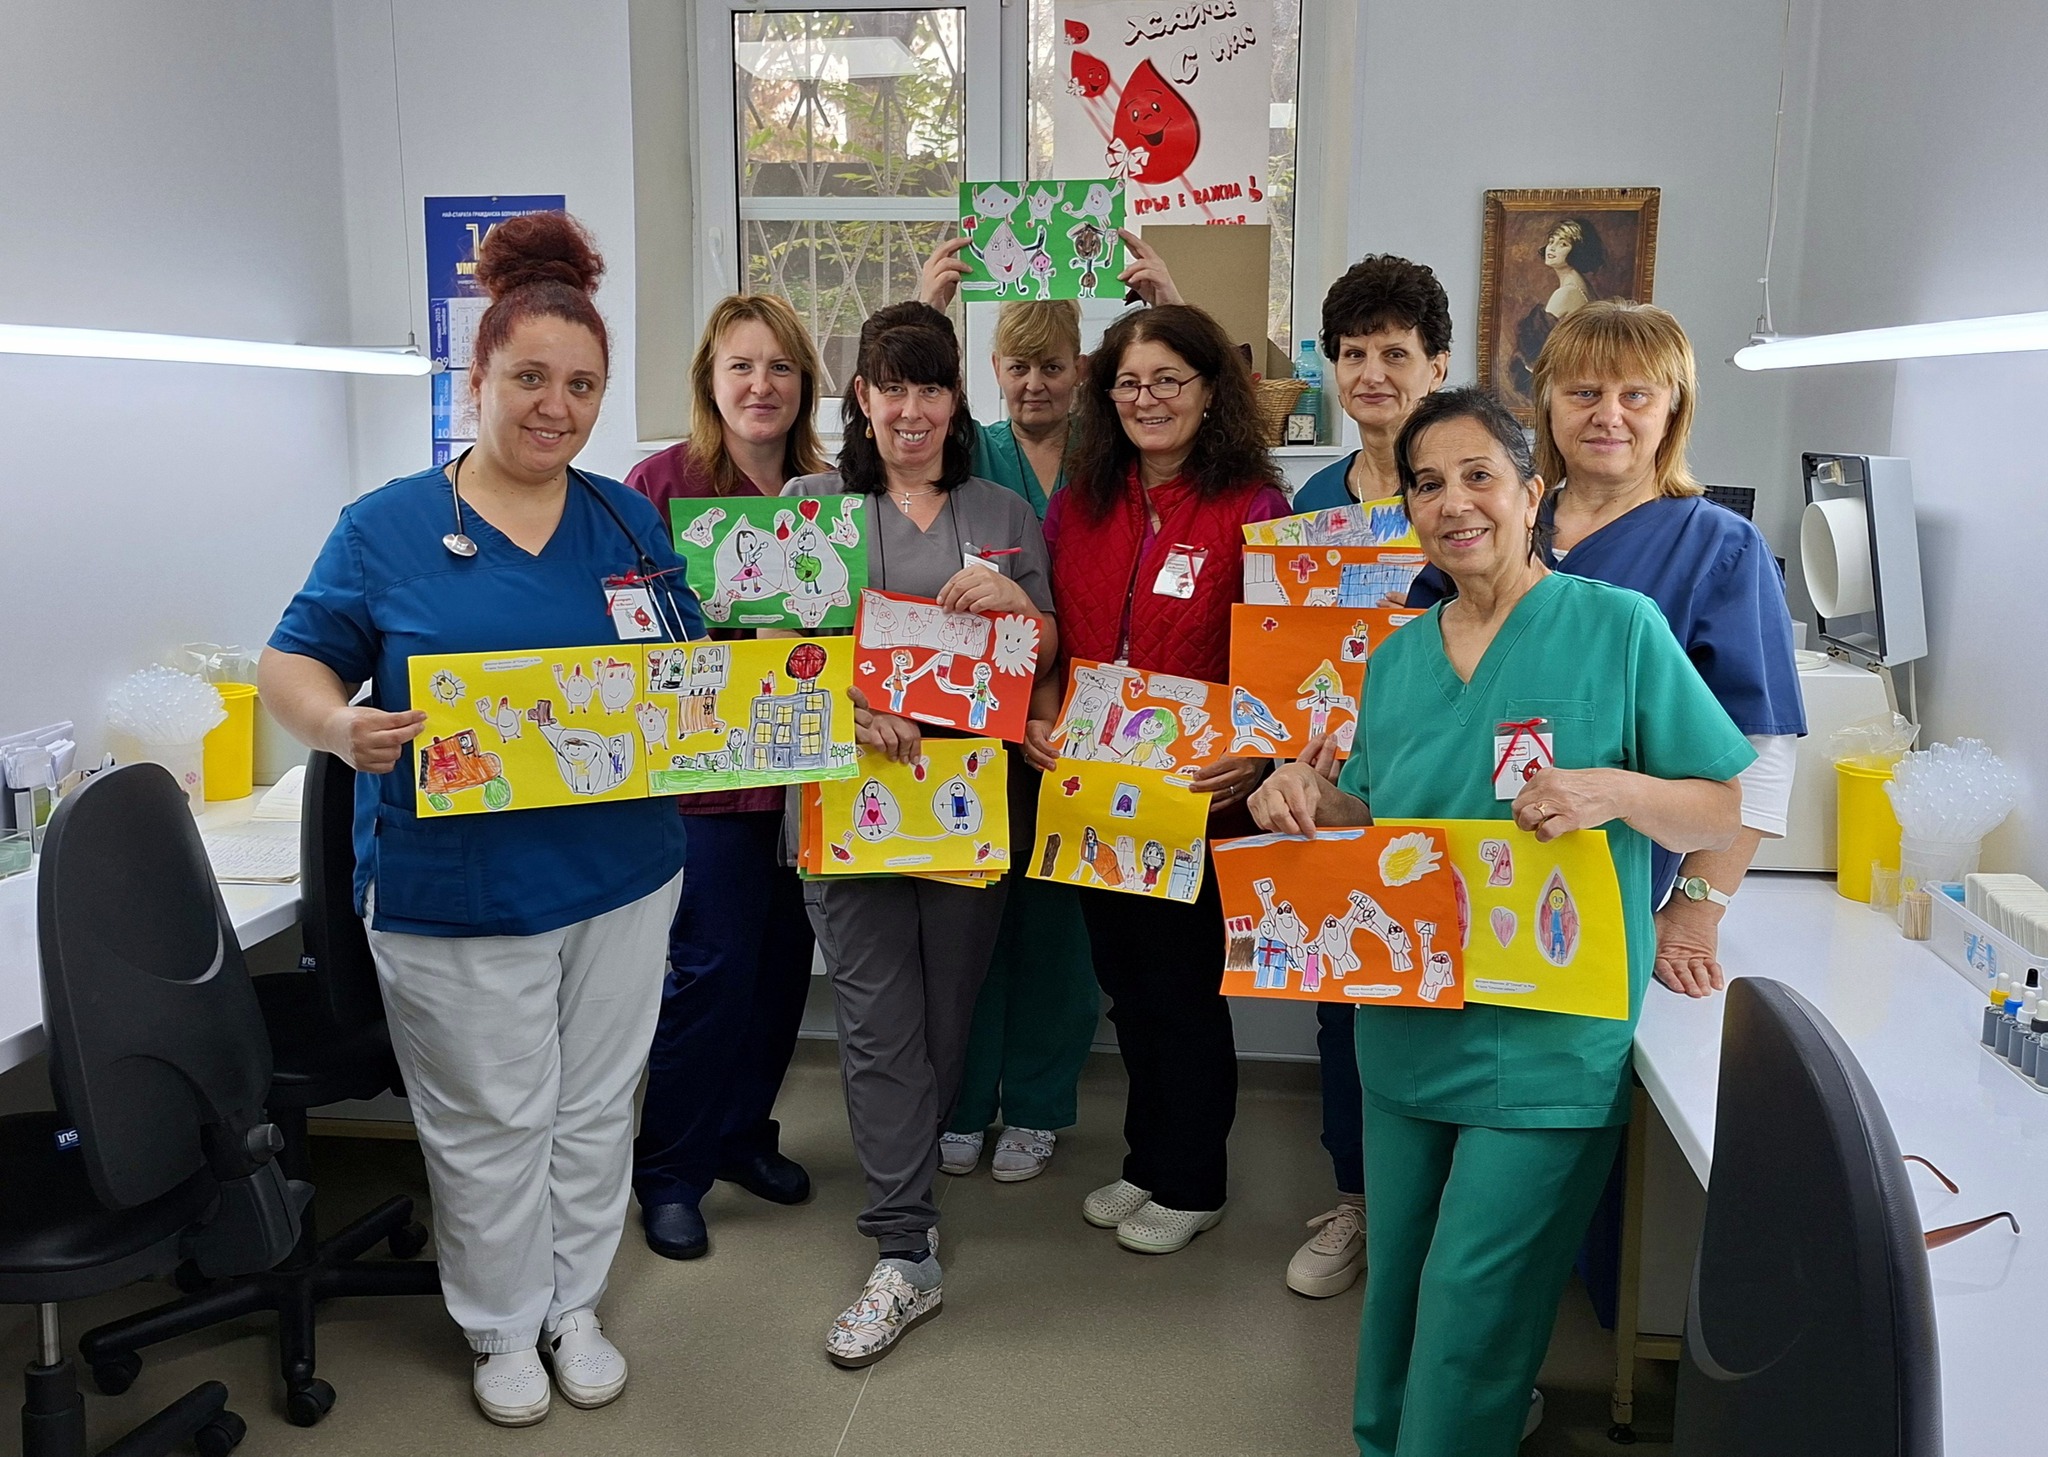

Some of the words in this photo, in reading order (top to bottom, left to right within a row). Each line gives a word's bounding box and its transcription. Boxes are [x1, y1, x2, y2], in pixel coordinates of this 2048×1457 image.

[1210, 22, 1257, 63] НАС
[1134, 195, 1171, 215] КРЪВ
[1178, 193, 1187, 207] Е
[1192, 182, 1243, 205] ВАЖНА
[437, 429, 449, 438] 10
